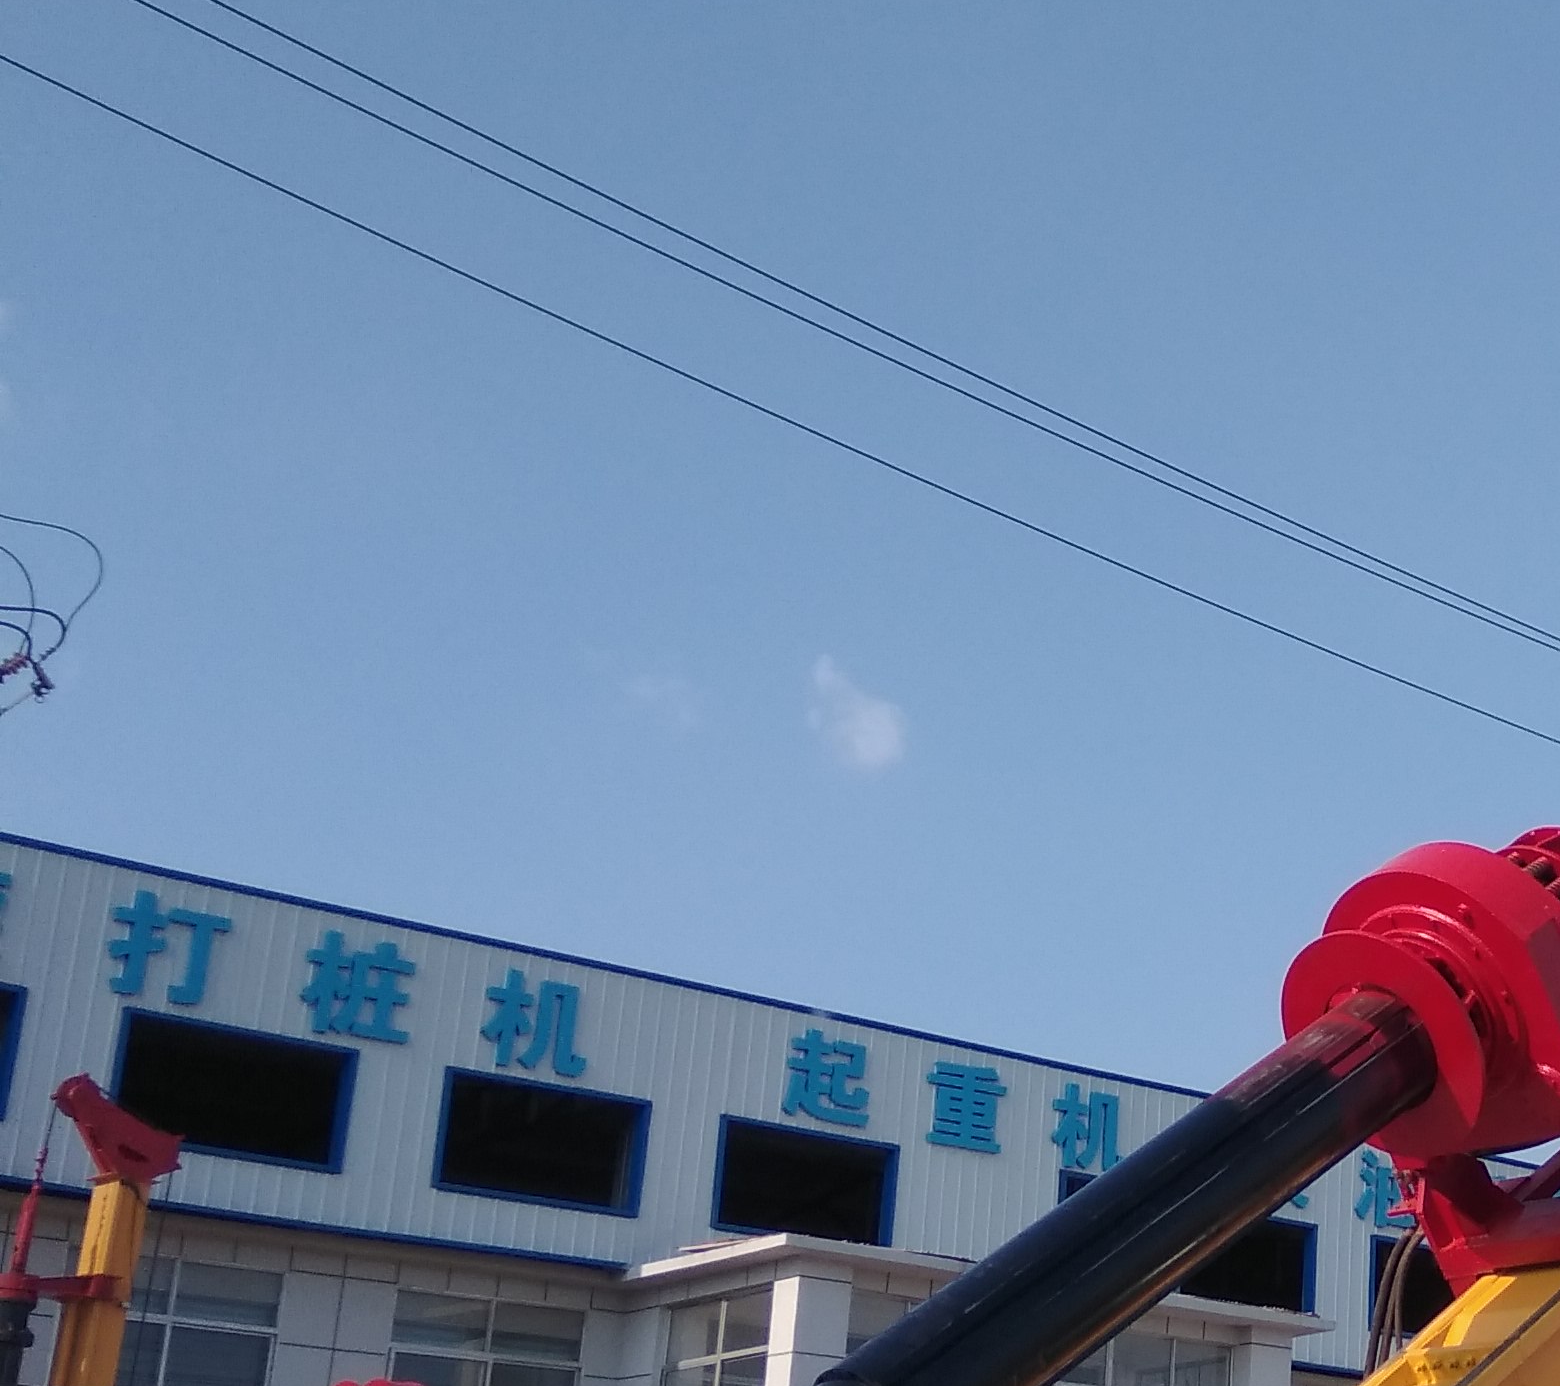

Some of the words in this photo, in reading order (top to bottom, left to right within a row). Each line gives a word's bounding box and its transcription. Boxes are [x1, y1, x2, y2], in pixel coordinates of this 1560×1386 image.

[0, 871, 587, 1078] 打桩机
[782, 1028, 1120, 1172] 起重机
